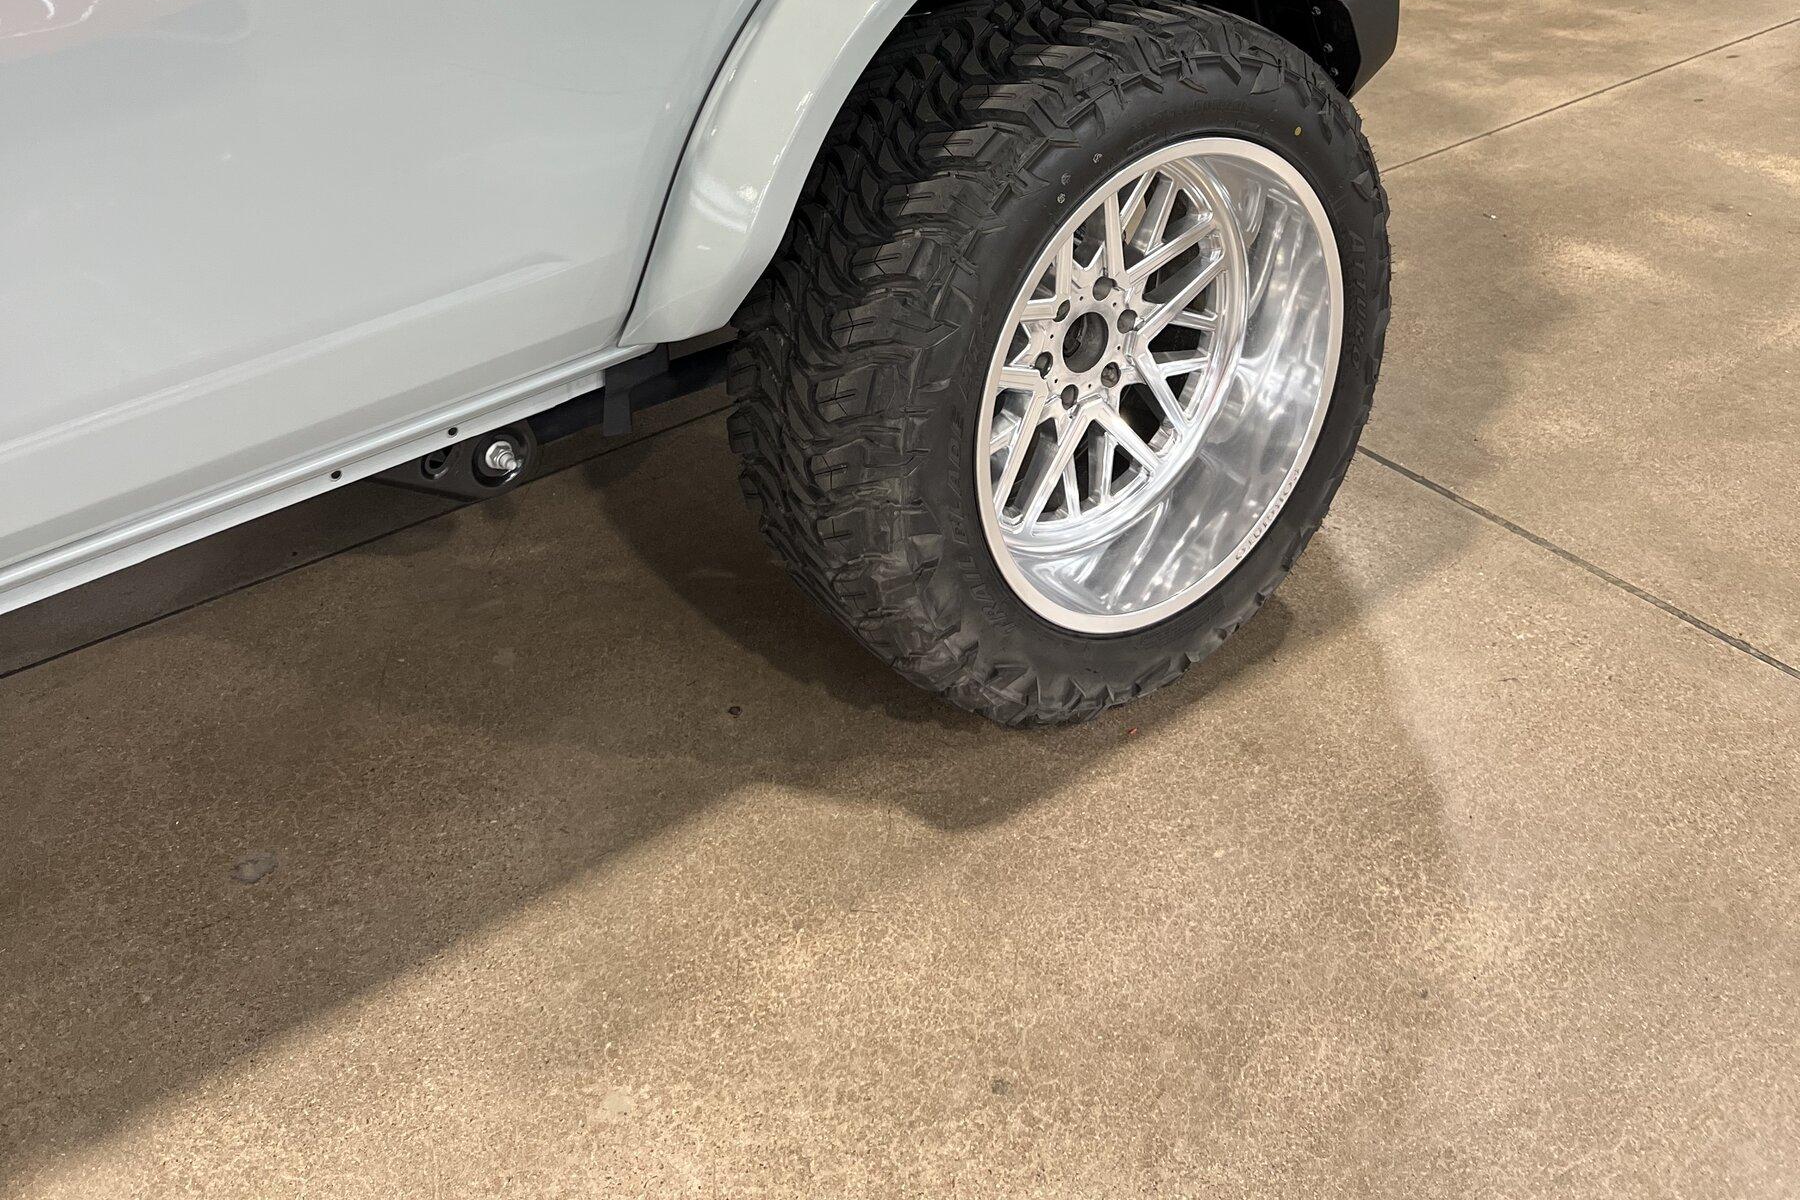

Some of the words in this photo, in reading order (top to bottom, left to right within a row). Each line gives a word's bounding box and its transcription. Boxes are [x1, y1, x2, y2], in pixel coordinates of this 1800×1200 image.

[1348, 229, 1369, 370] ATTURO
[945, 406, 971, 546] BLADE
[957, 555, 1017, 635] TRAIL
